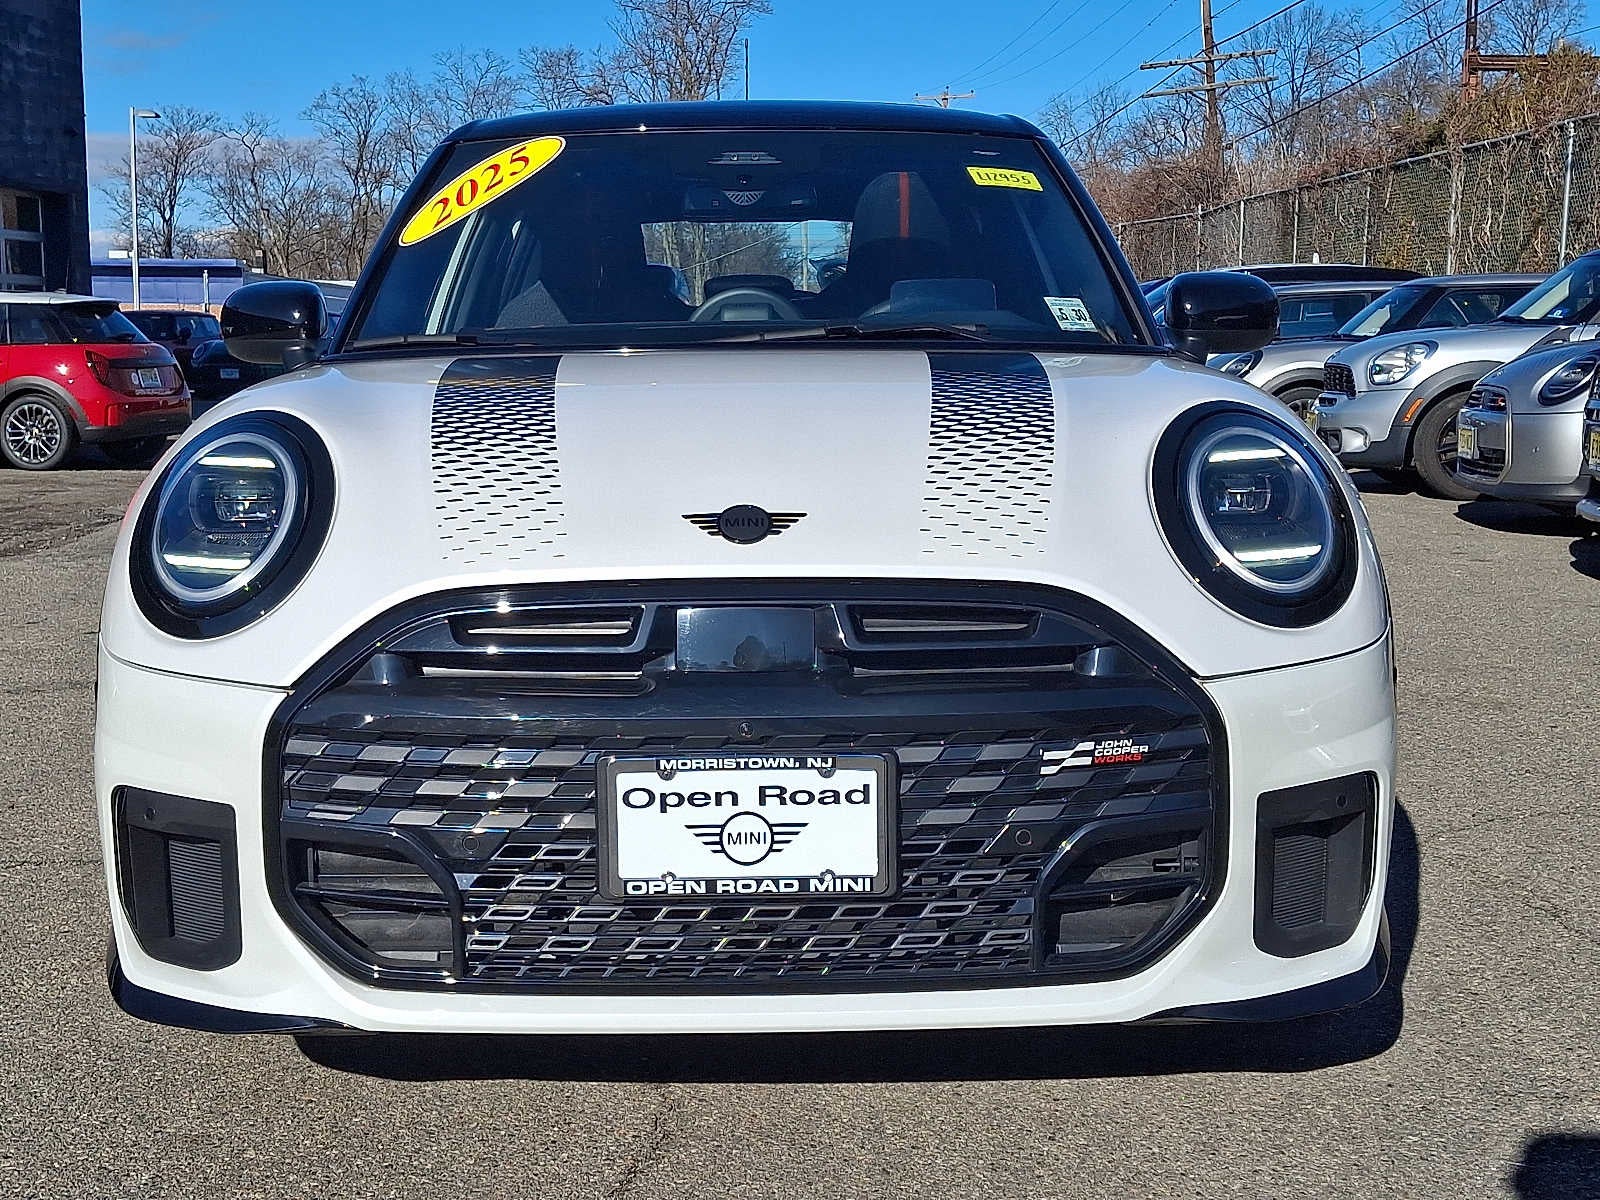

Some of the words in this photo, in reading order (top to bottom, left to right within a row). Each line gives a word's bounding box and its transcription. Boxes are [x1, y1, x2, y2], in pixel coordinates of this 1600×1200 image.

[430, 146, 530, 230] 2025
[1071, 308, 1088, 322] 30
[724, 518, 765, 528] MINI
[1095, 739, 1133, 749] JOHN
[1094, 745, 1149, 757] COOPER
[807, 757, 833, 769] NJ
[1093, 753, 1142, 764] WORKS
[622, 787, 739, 813] Open
[758, 784, 870, 807] Road
[727, 831, 767, 846] MINI
[626, 878, 706, 895] OPEN
[716, 878, 800, 894] ROAD
[809, 876, 871, 892] MINI
